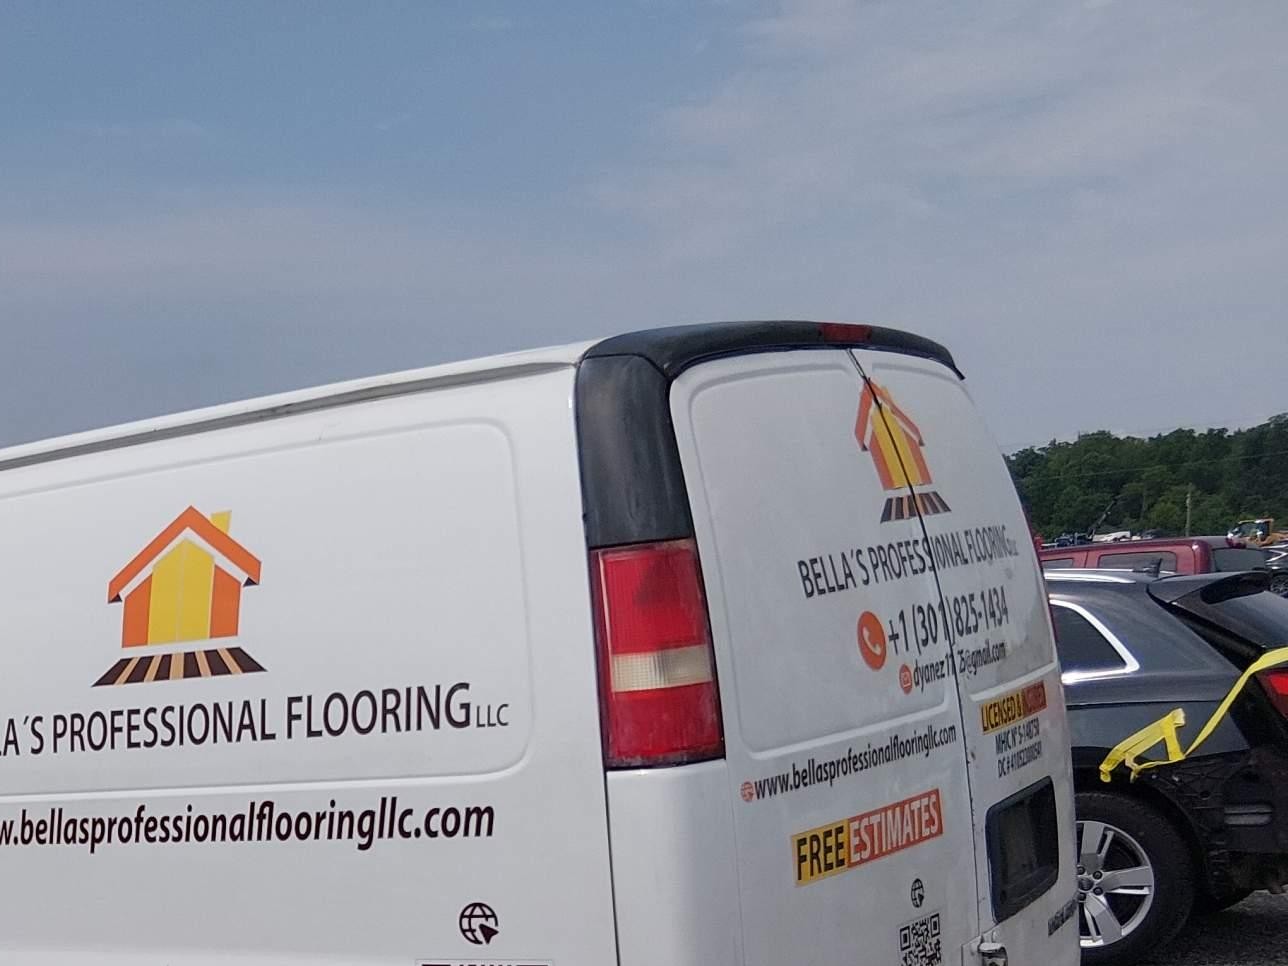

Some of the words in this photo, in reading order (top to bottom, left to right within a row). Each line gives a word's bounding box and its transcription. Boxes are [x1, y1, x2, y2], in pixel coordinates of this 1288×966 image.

[868, 531, 968, 583] PROFESSIONAL
[964, 525, 1010, 564] FLOORING
[888, 609, 910, 655] +1
[912, 596, 956, 656] (301)
[953, 586, 1010, 638] 825-1434
[52, 698, 277, 754] PROFESSIONAL
[286, 682, 471, 740] FLOORING
[476, 703, 510, 729] LLC
[981, 696, 1016, 732] LICENSED
[1016, 693, 1022, 718] &
[754, 723, 957, 799] www.bellasprofessionalflooringllc.com
[797, 826, 846, 882] FREE
[849, 792, 940, 863] ESTIMATES
